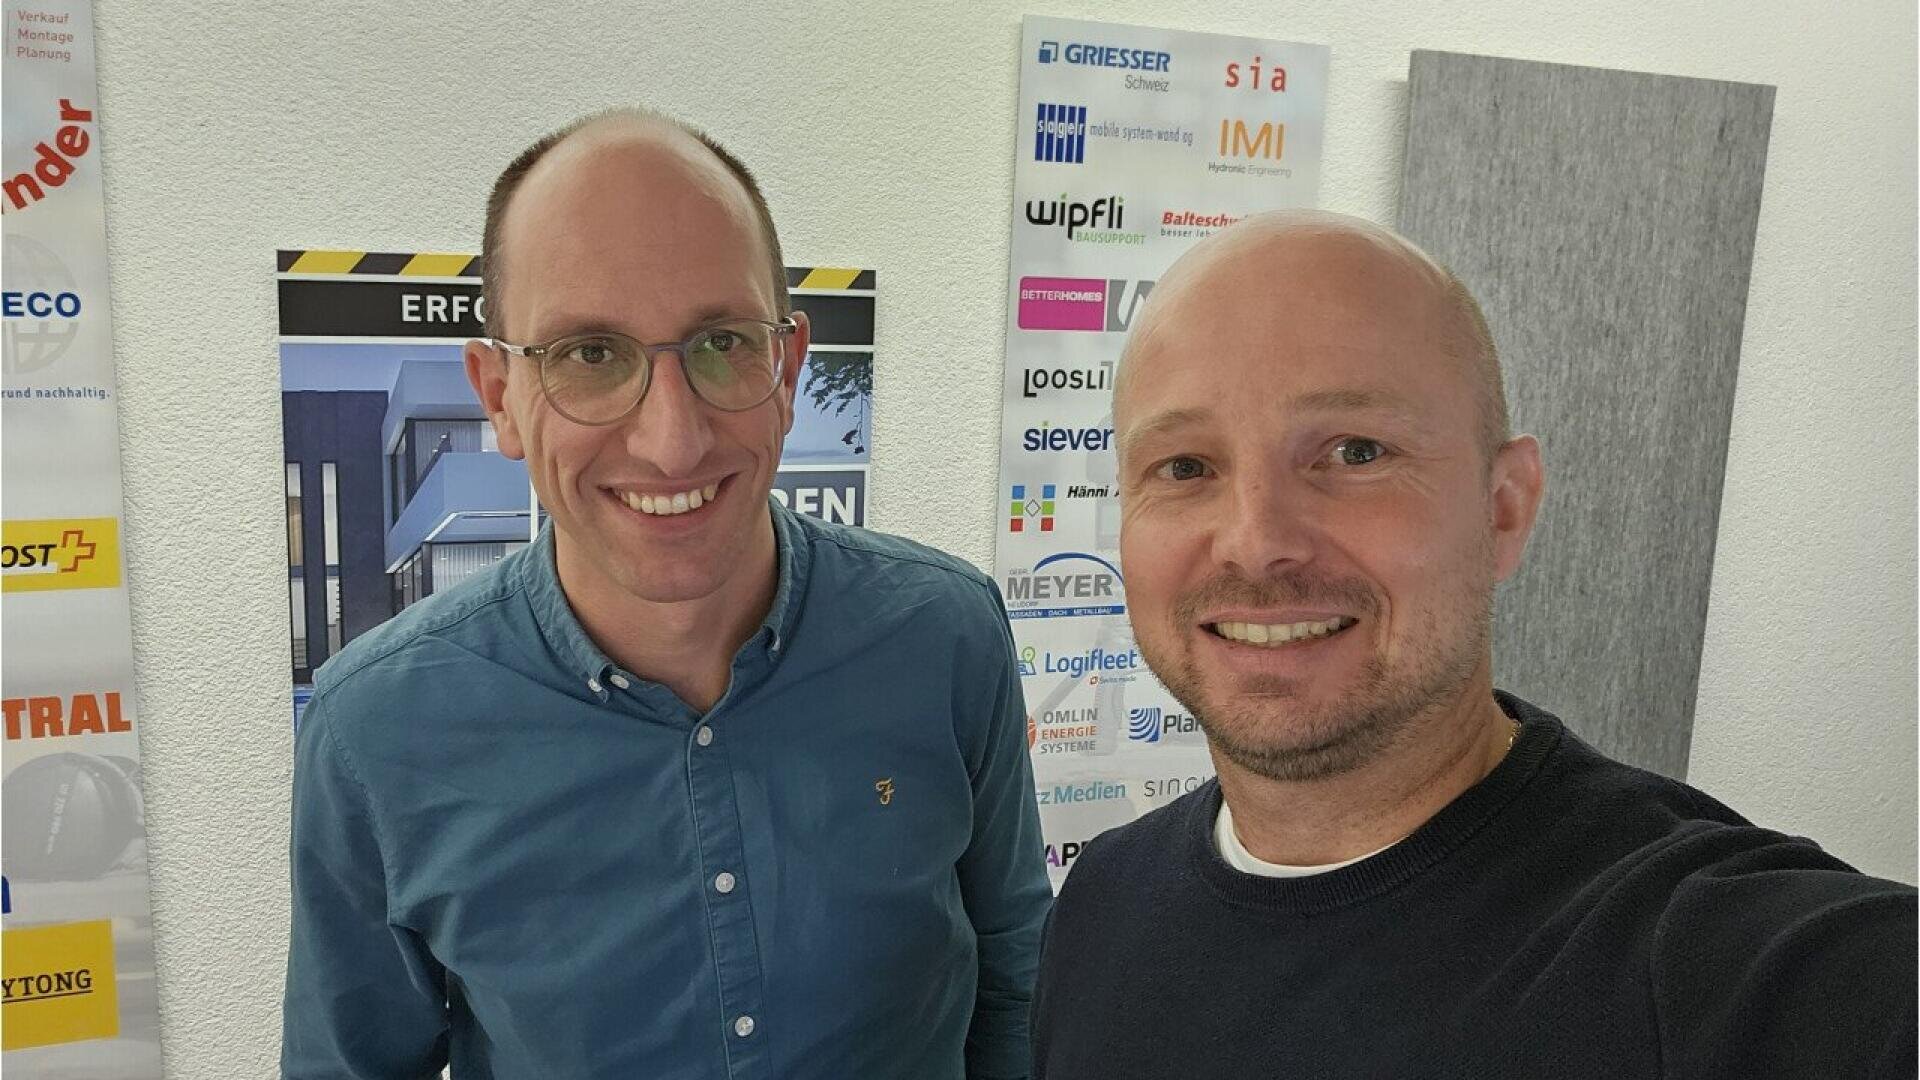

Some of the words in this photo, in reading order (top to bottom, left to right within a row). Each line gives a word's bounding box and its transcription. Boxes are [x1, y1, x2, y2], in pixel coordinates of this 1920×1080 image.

[18, 10, 69, 23] Verkauf
[18, 28, 74, 44] Montage
[17, 46, 71, 62] Planung
[1065, 44, 1171, 72] GRIESSER
[1226, 57, 1286, 91] sia
[1125, 75, 1169, 92] Schweiz
[1090, 121, 1120, 138] mobile
[1220, 120, 1284, 160] IMI
[2, 99, 92, 215] nder
[1026, 193, 1124, 240] wipfli
[1077, 231, 1146, 245] BAUSUPPORT
[1161, 228, 1192, 238] besser
[1022, 289, 1103, 302] BETTERHOMES
[2, 292, 81, 317] ECO
[36, 387, 111, 399] nachhaltig.
[1067, 485, 1109, 498] Hänni
[1007, 574, 1113, 600] MEYER
[1045, 648, 1138, 678] Logifleet
[2, 692, 132, 739] TRAL
[1043, 708, 1098, 724] OMLIN
[1041, 725, 1097, 739] ENERGIE
[1040, 740, 1096, 754] SYSTEME
[1054, 781, 1126, 804] Medien
[1045, 841, 1089, 867] AP
[2, 968, 92, 997] YTONG
